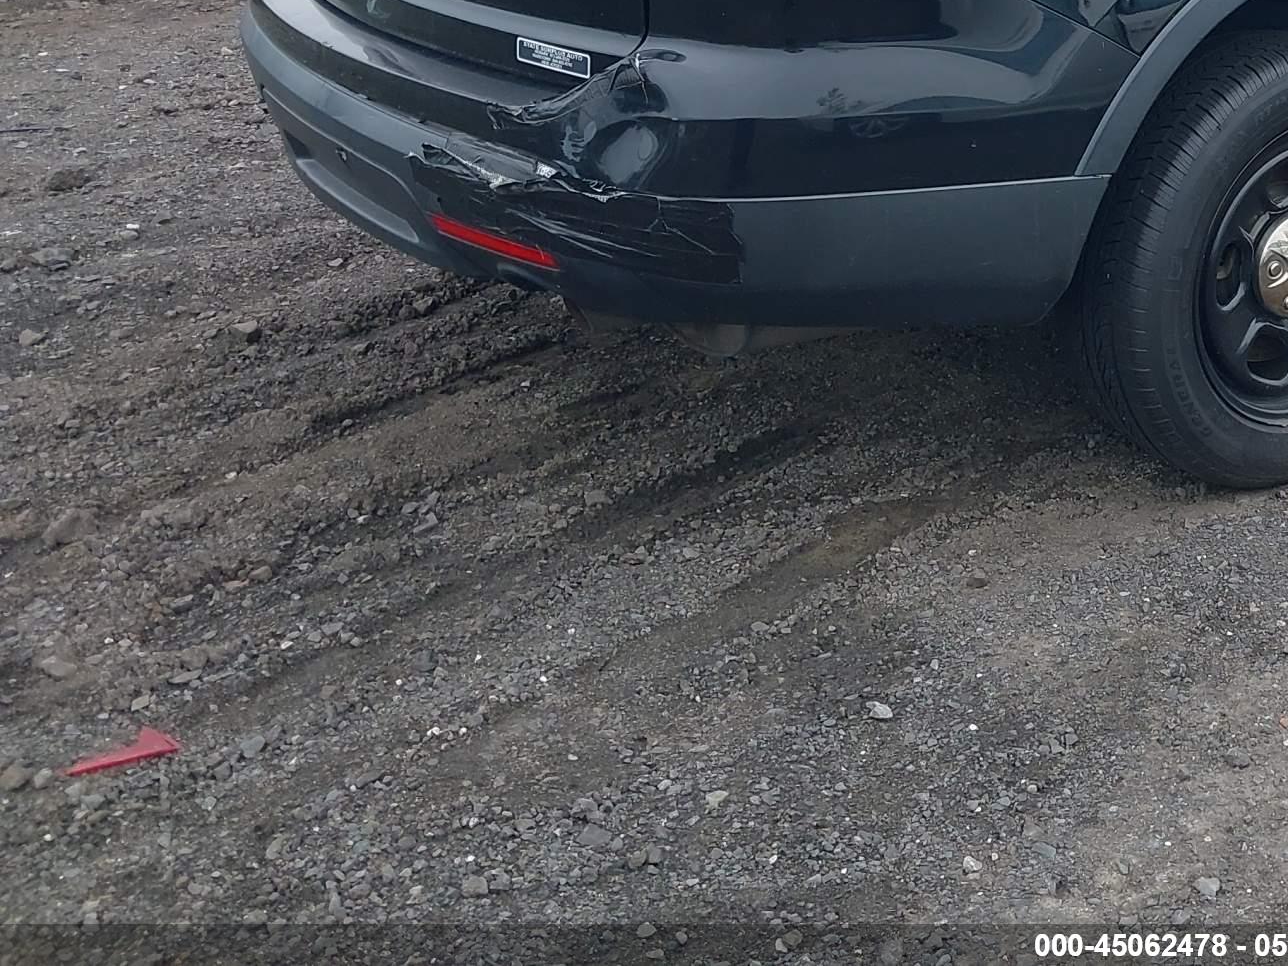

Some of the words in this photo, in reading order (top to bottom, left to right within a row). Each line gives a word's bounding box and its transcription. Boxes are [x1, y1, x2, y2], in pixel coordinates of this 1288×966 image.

[523, 41, 540, 51] STATE
[540, 44, 566, 58] SURPLUS
[566, 52, 583, 62] AUTO
